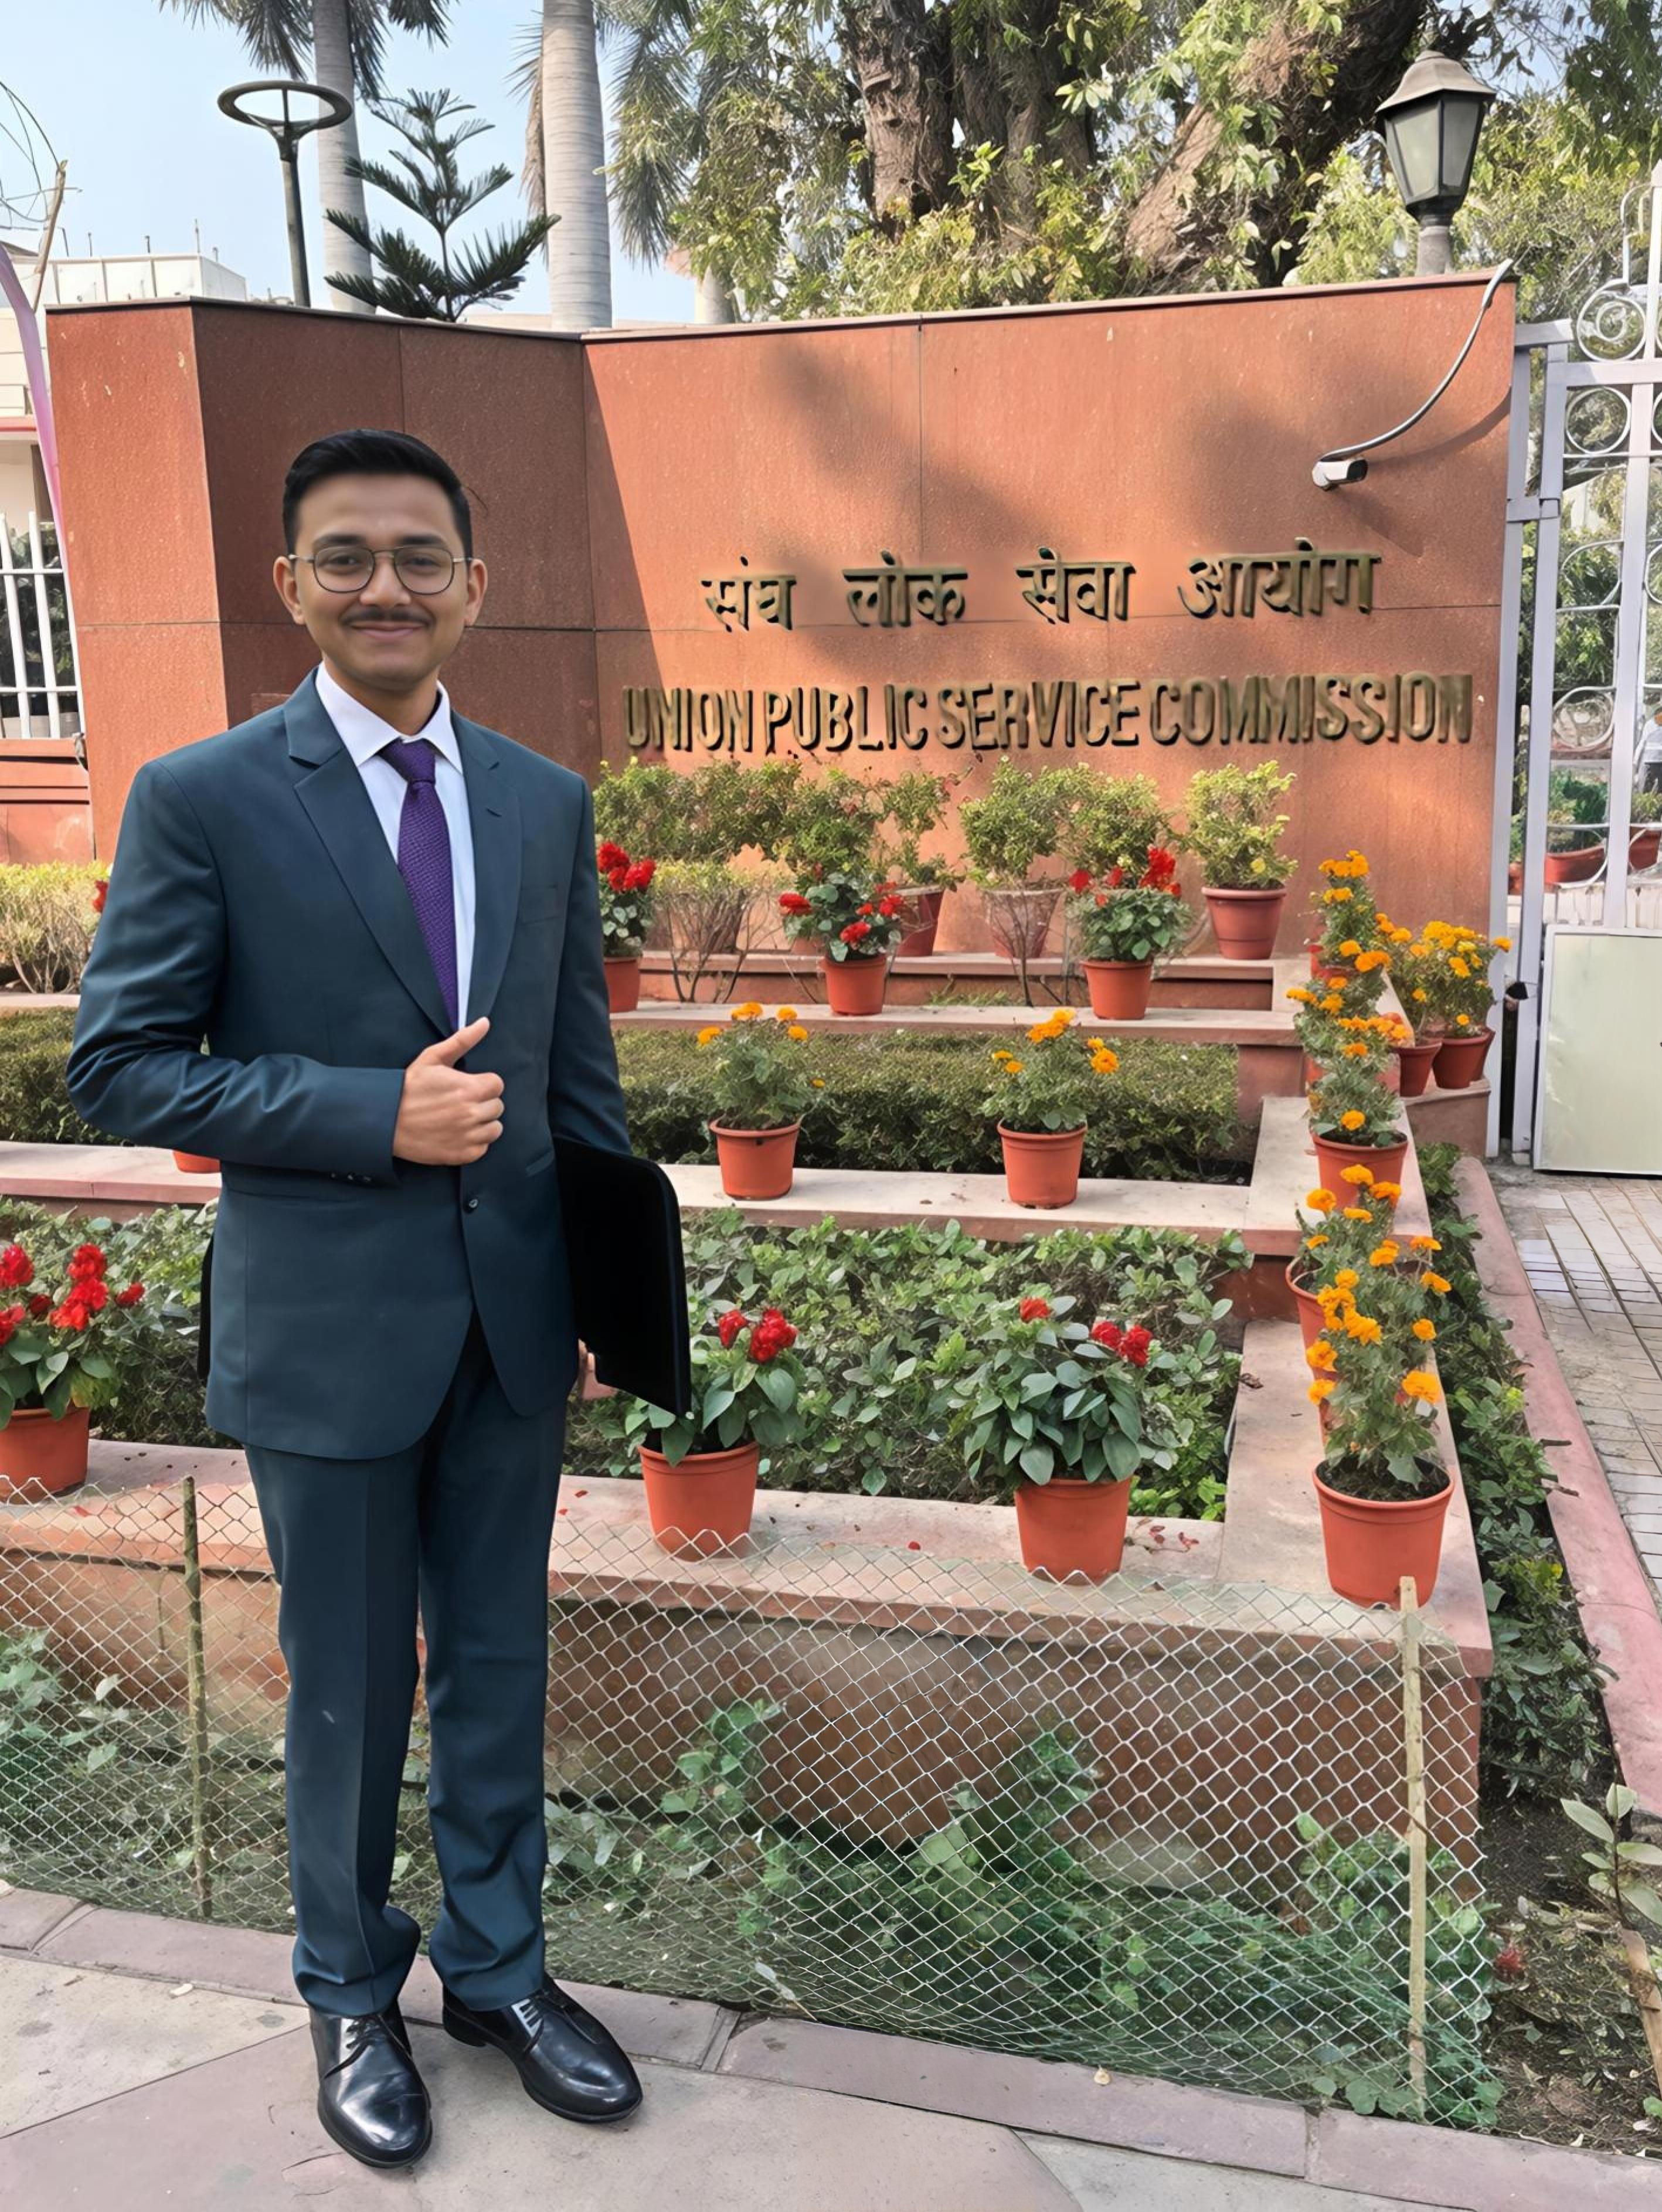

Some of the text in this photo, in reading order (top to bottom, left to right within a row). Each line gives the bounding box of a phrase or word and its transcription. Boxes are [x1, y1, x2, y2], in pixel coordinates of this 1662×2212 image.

[701, 536, 1382, 631] संघ लोक सेवा आयोग
[623, 672, 1473, 753] UNION PUBLIC SERVICE COMMISSION
